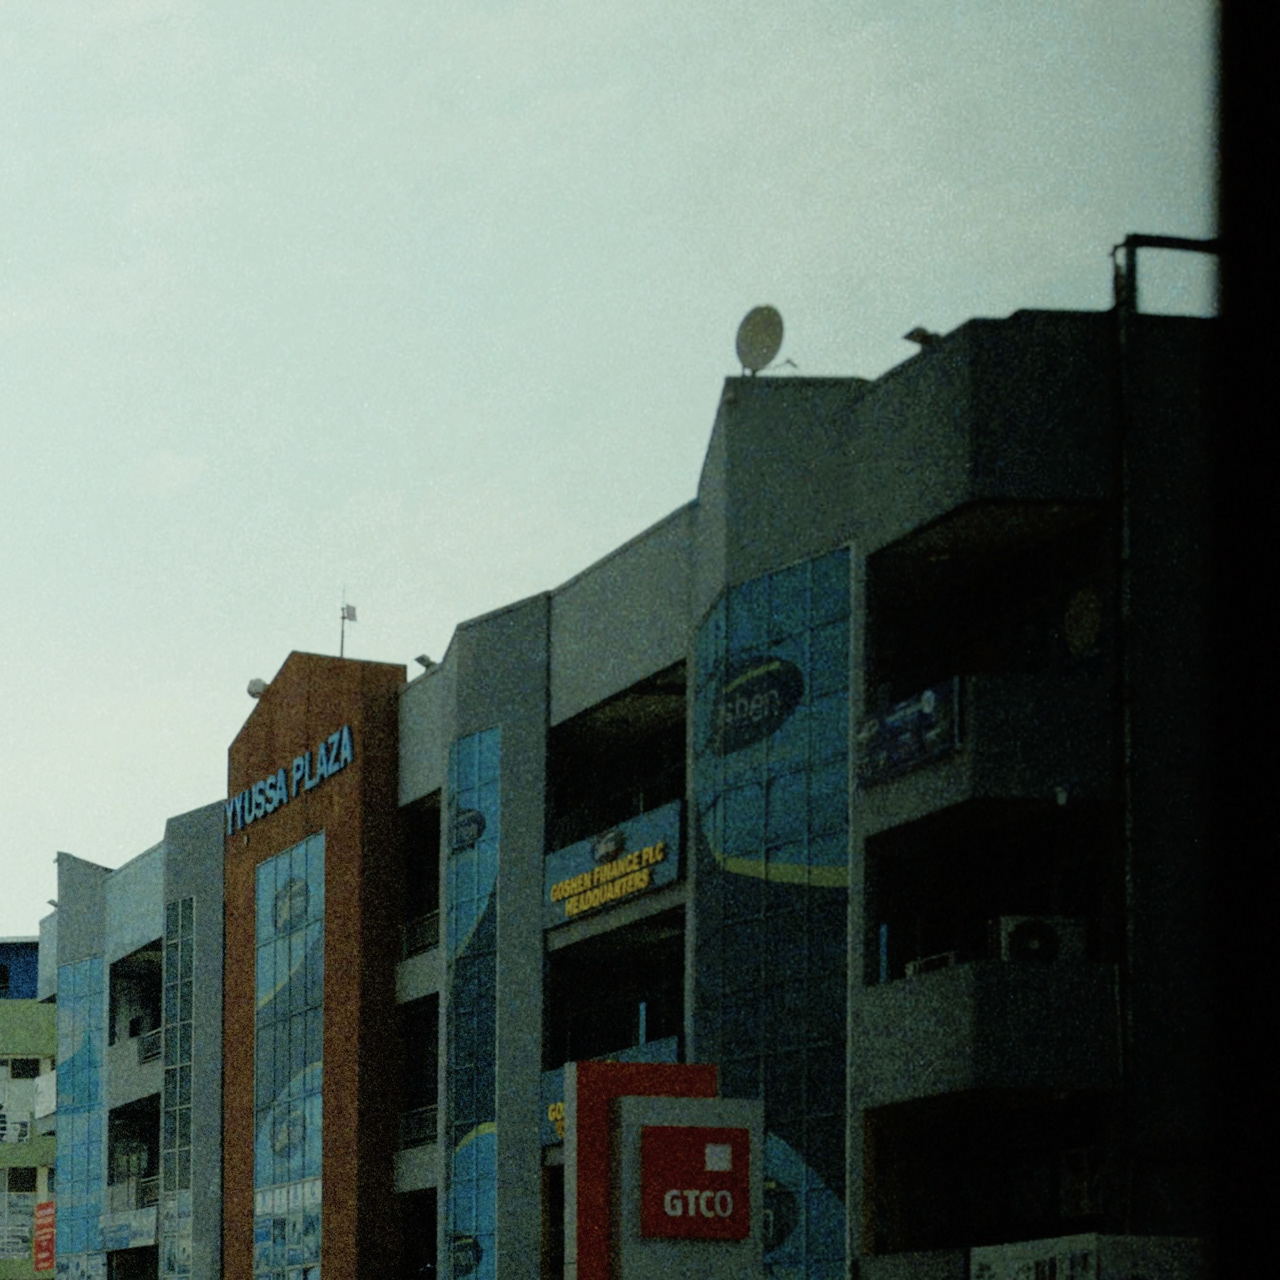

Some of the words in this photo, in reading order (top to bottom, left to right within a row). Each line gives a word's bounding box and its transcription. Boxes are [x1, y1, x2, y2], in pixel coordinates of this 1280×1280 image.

[225, 767, 288, 836] YYUSSA
[292, 724, 354, 798] PLAZA
[663, 1188, 733, 1218] GTCO
